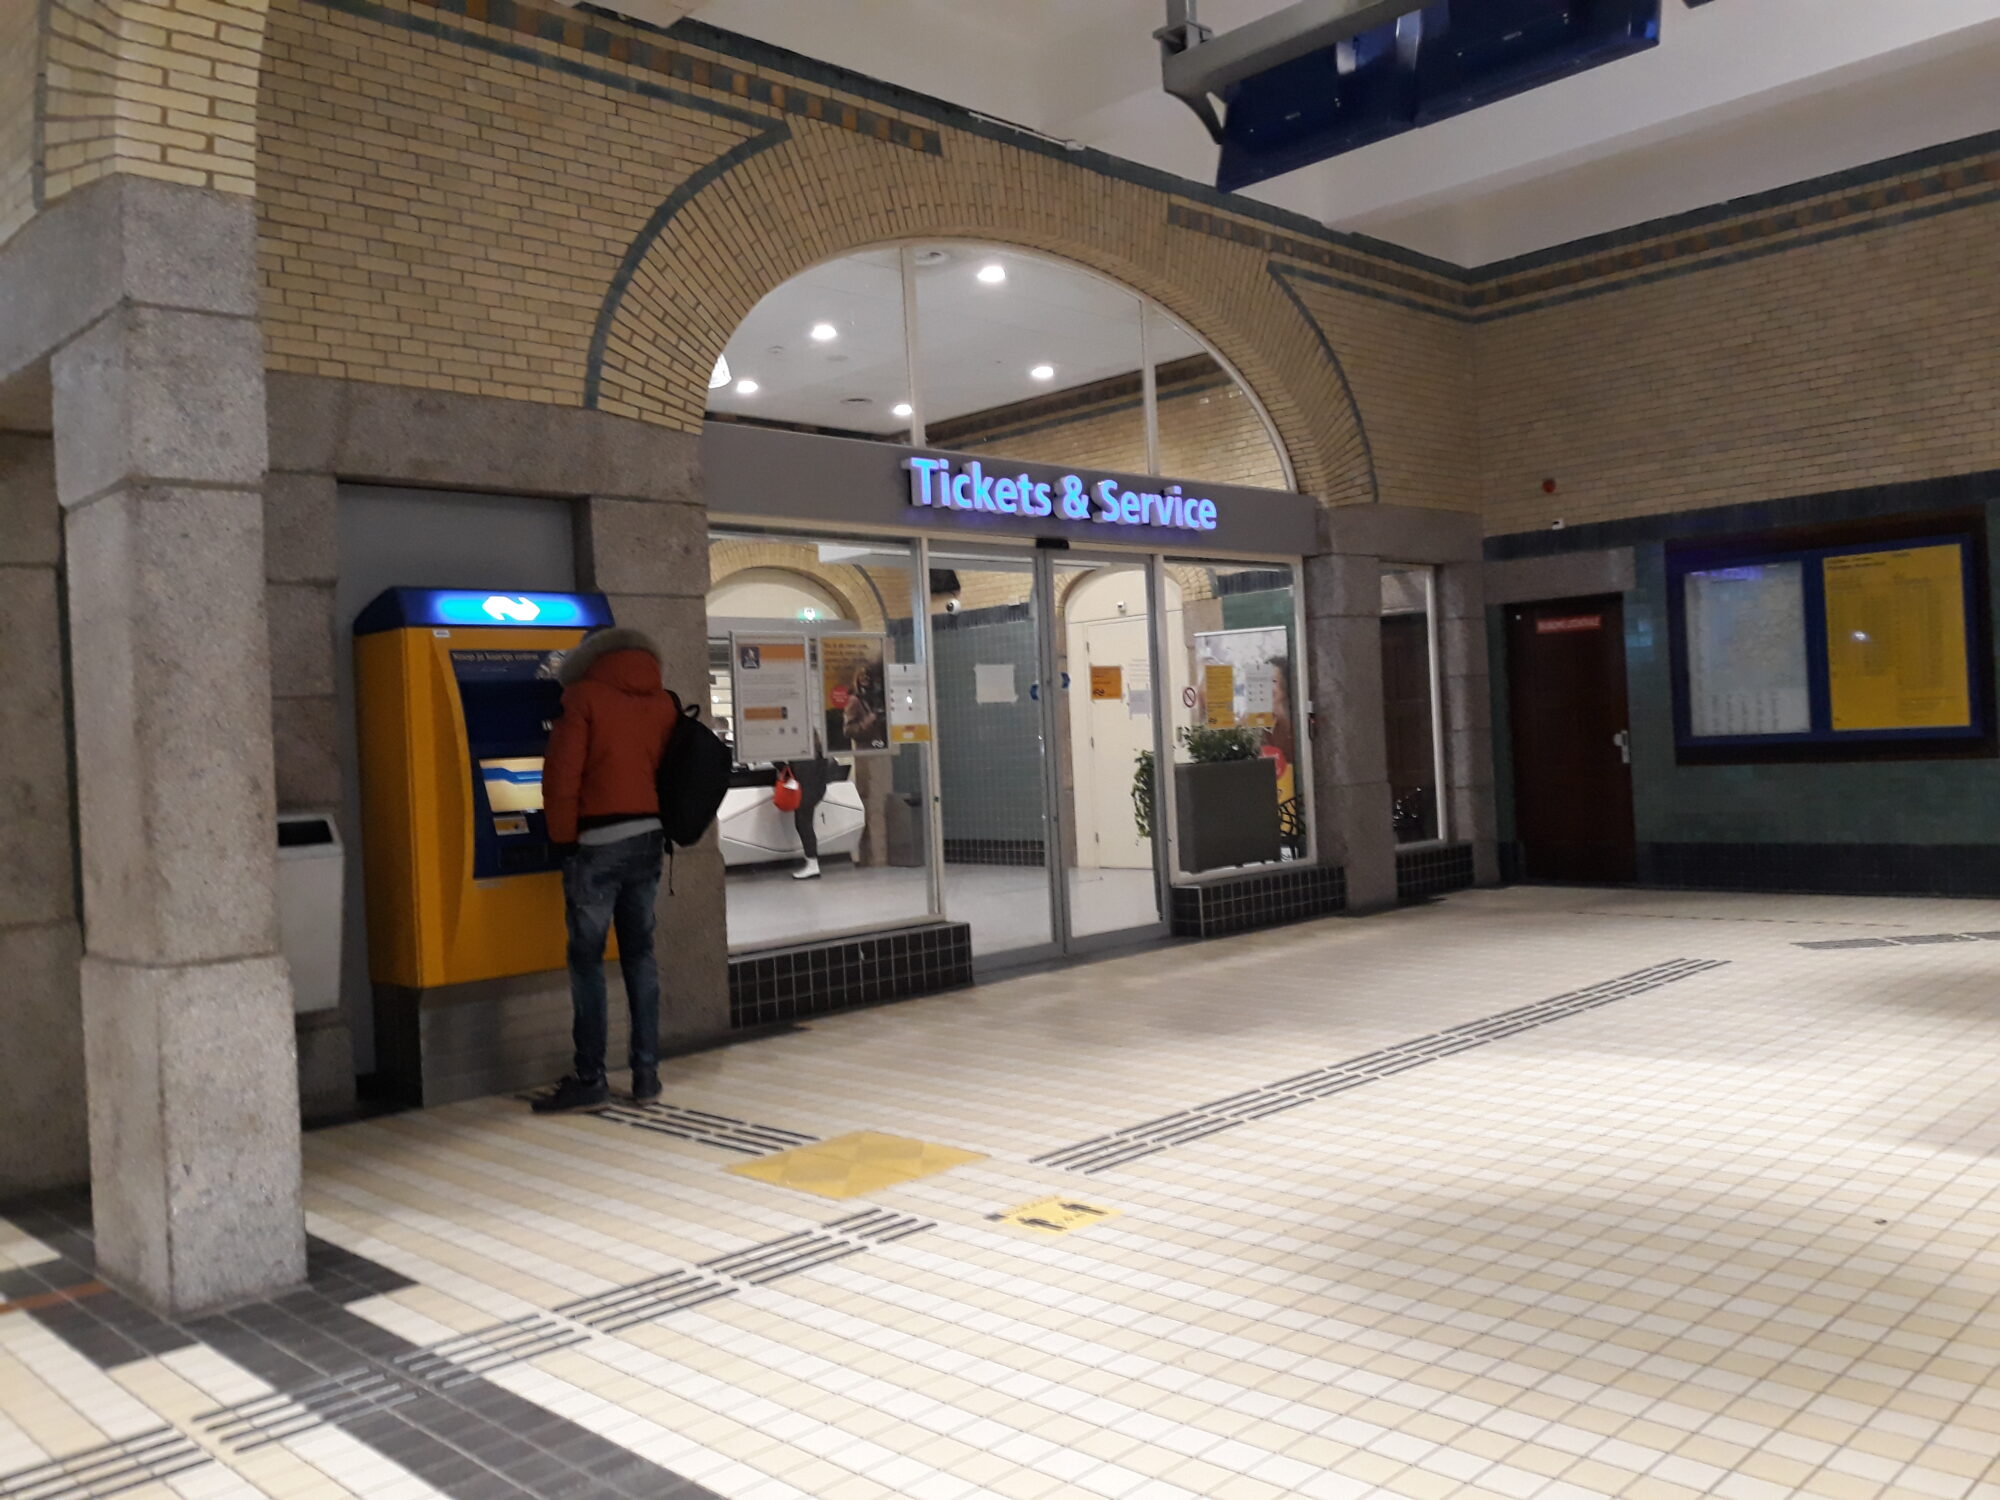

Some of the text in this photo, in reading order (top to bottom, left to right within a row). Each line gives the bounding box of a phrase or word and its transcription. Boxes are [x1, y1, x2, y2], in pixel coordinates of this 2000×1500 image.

[909, 457, 1218, 530] Tickets & Service
